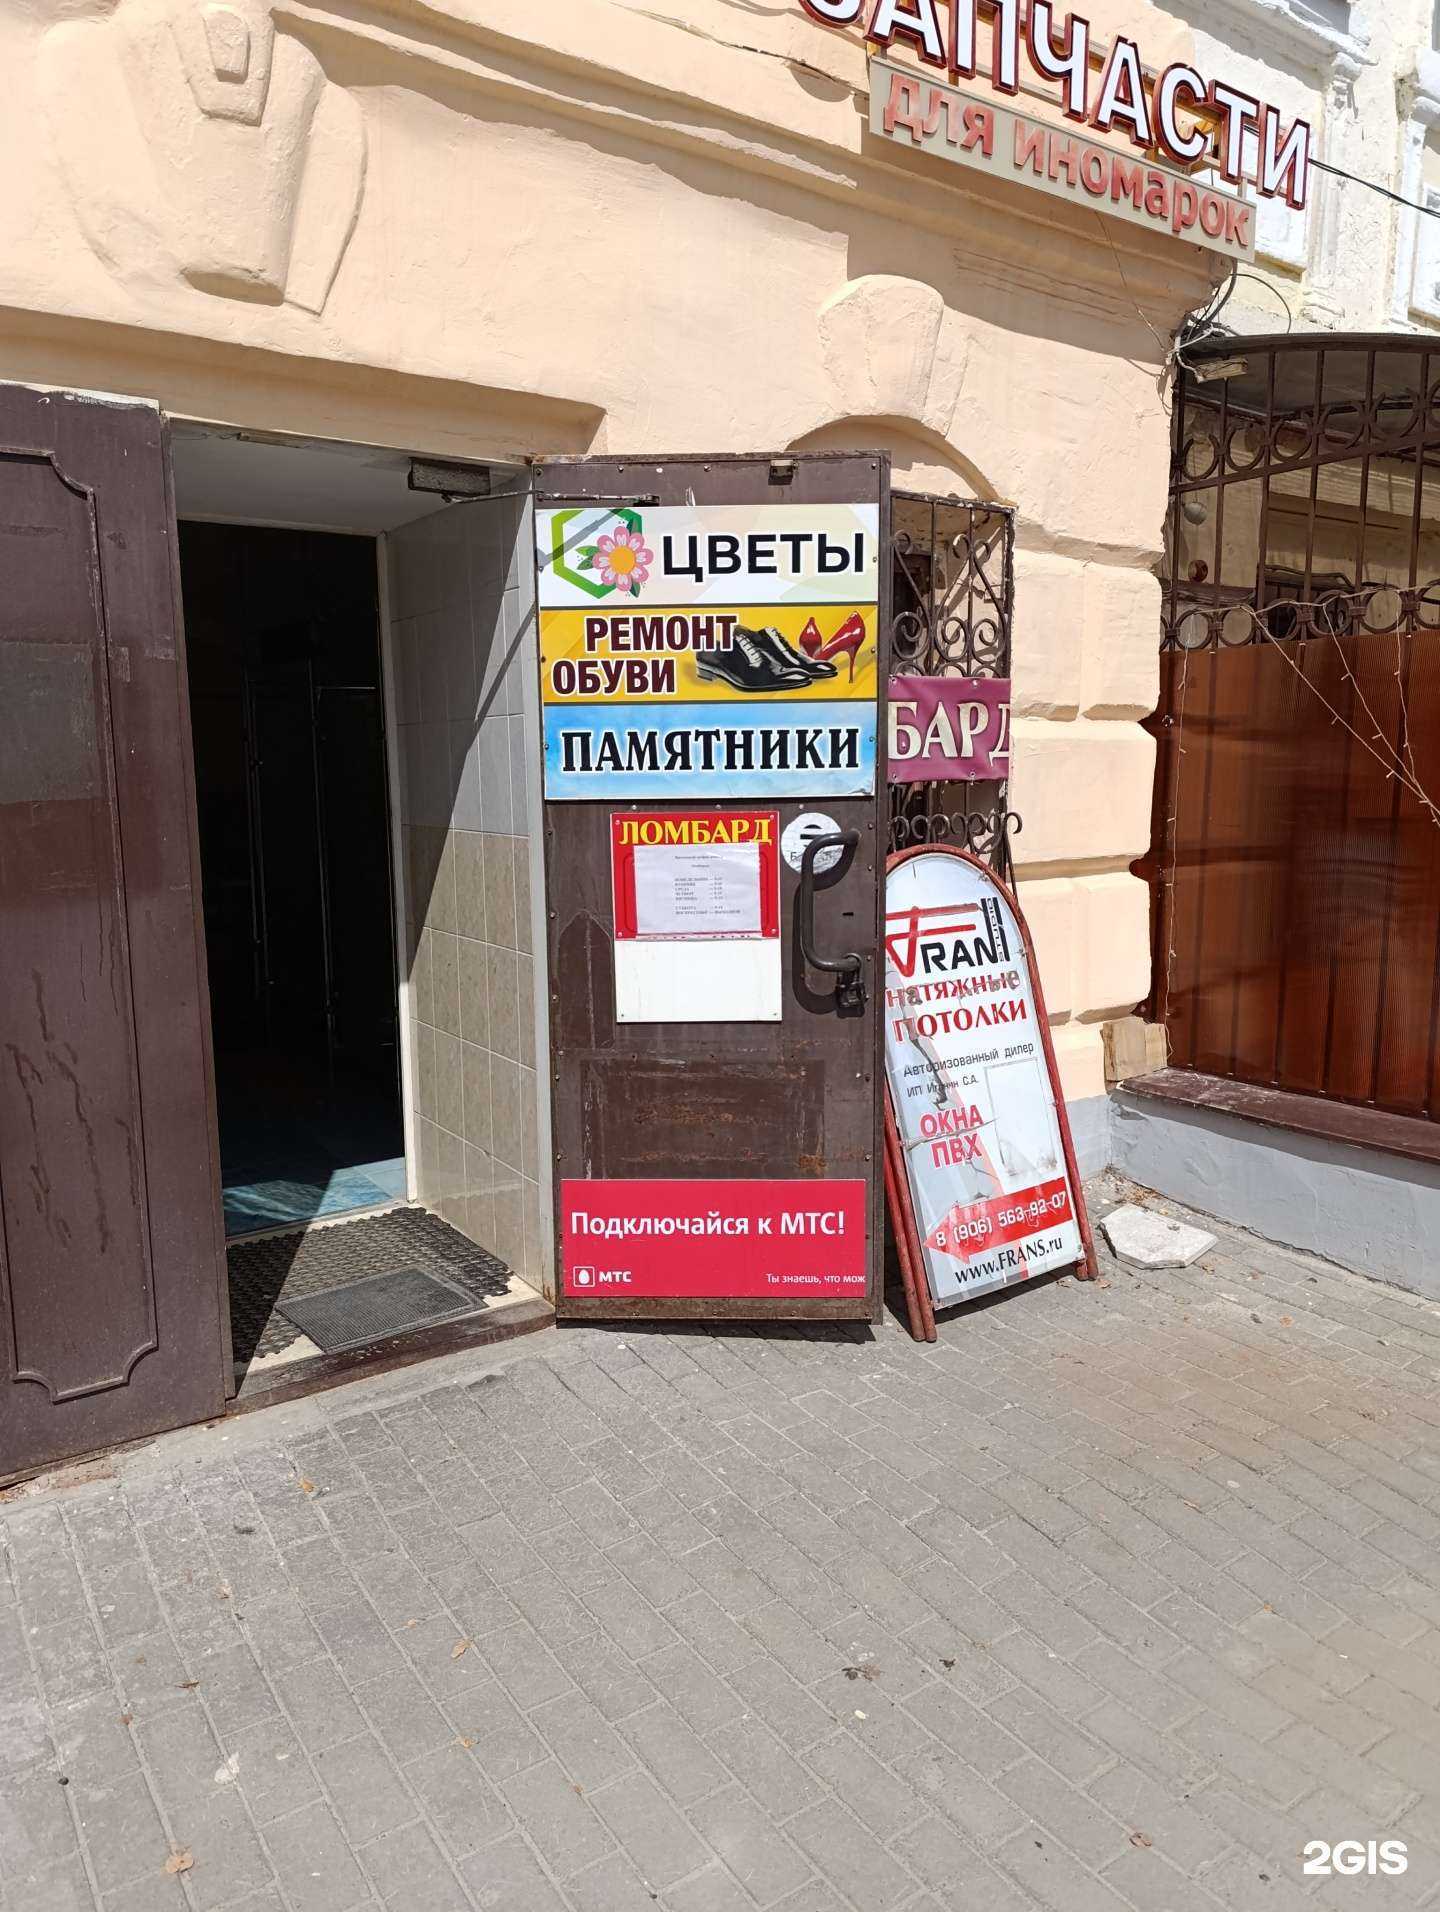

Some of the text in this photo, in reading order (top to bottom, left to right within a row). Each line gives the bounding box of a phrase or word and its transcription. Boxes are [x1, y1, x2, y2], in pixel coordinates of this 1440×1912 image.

[883, 73, 1249, 247] для иномарок
[662, 532, 865, 583] ЦВЕТЫ
[585, 615, 738, 652] РЕМОНТ
[552, 659, 675, 695] ОБУВИ
[561, 728, 860, 772] ПАМЯТНИКИ
[619, 818, 773, 846] ЛОМБАРД
[903, 1042, 1034, 1078] Авторизованный дилер
[907, 1085, 923, 1097] ИП
[919, 1104, 984, 1138] ОКНА
[931, 1133, 983, 1168] ПВХ
[571, 1210, 845, 1239] Подключайся к МТС!
[936, 1231, 946, 1246] 8
[955, 1237, 1063, 1284] www.FRANS.ru
[766, 1273, 866, 1285] Ты знаешь, что мож
